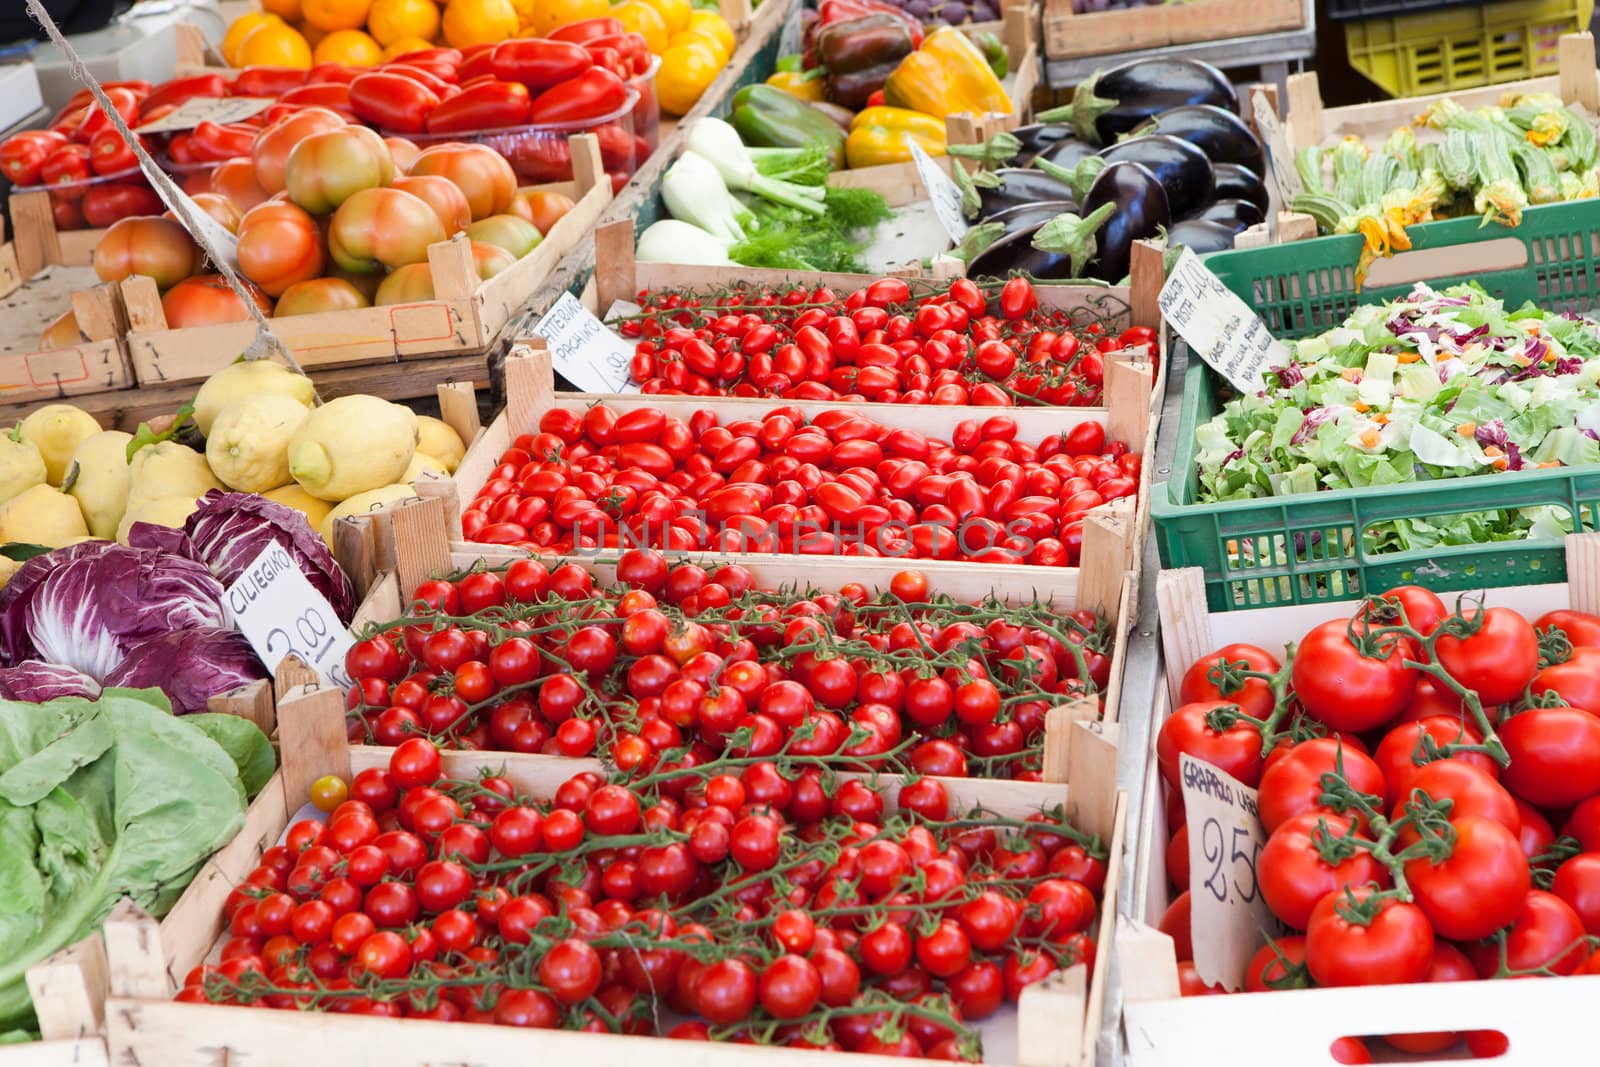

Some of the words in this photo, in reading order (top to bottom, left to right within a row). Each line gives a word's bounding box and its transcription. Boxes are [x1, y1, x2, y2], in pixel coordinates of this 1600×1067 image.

[555, 318, 601, 363] PACHINO
[229, 548, 291, 615] CILIEGINO
[266, 607, 327, 665] 3.00
